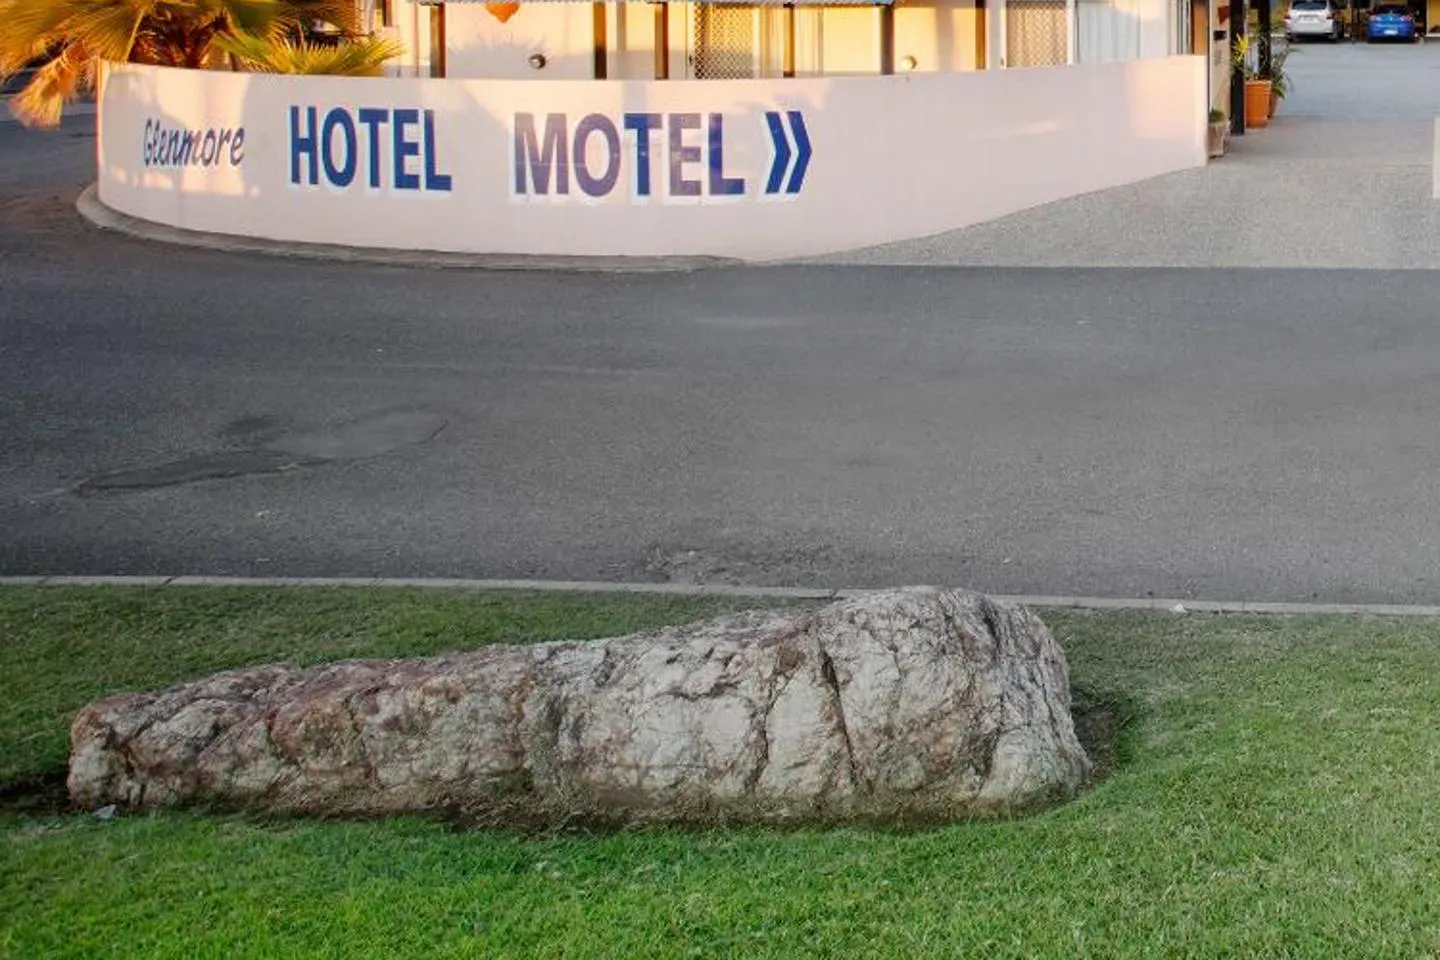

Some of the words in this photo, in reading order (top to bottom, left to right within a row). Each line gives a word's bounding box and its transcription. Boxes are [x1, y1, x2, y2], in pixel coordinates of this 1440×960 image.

[143, 117, 246, 171] Glenmore
[290, 105, 452, 192] HOTEL
[513, 111, 746, 196] MOTEL
